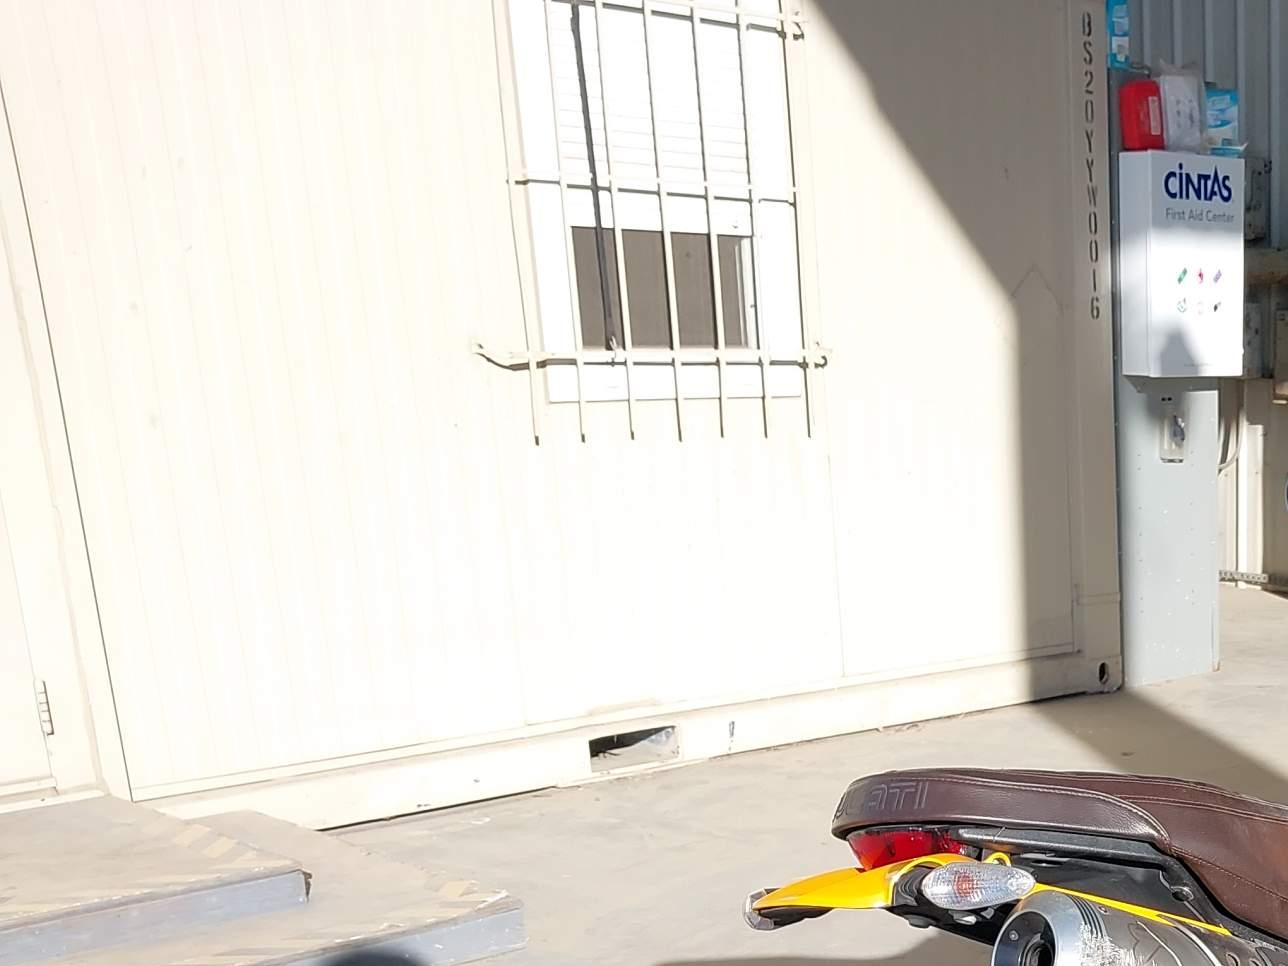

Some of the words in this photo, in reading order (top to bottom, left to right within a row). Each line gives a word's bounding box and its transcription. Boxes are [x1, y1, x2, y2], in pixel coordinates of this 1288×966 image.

[1165, 207, 1185, 220] First
[1188, 209, 1203, 221] Aid
[1206, 210, 1235, 222] Center
